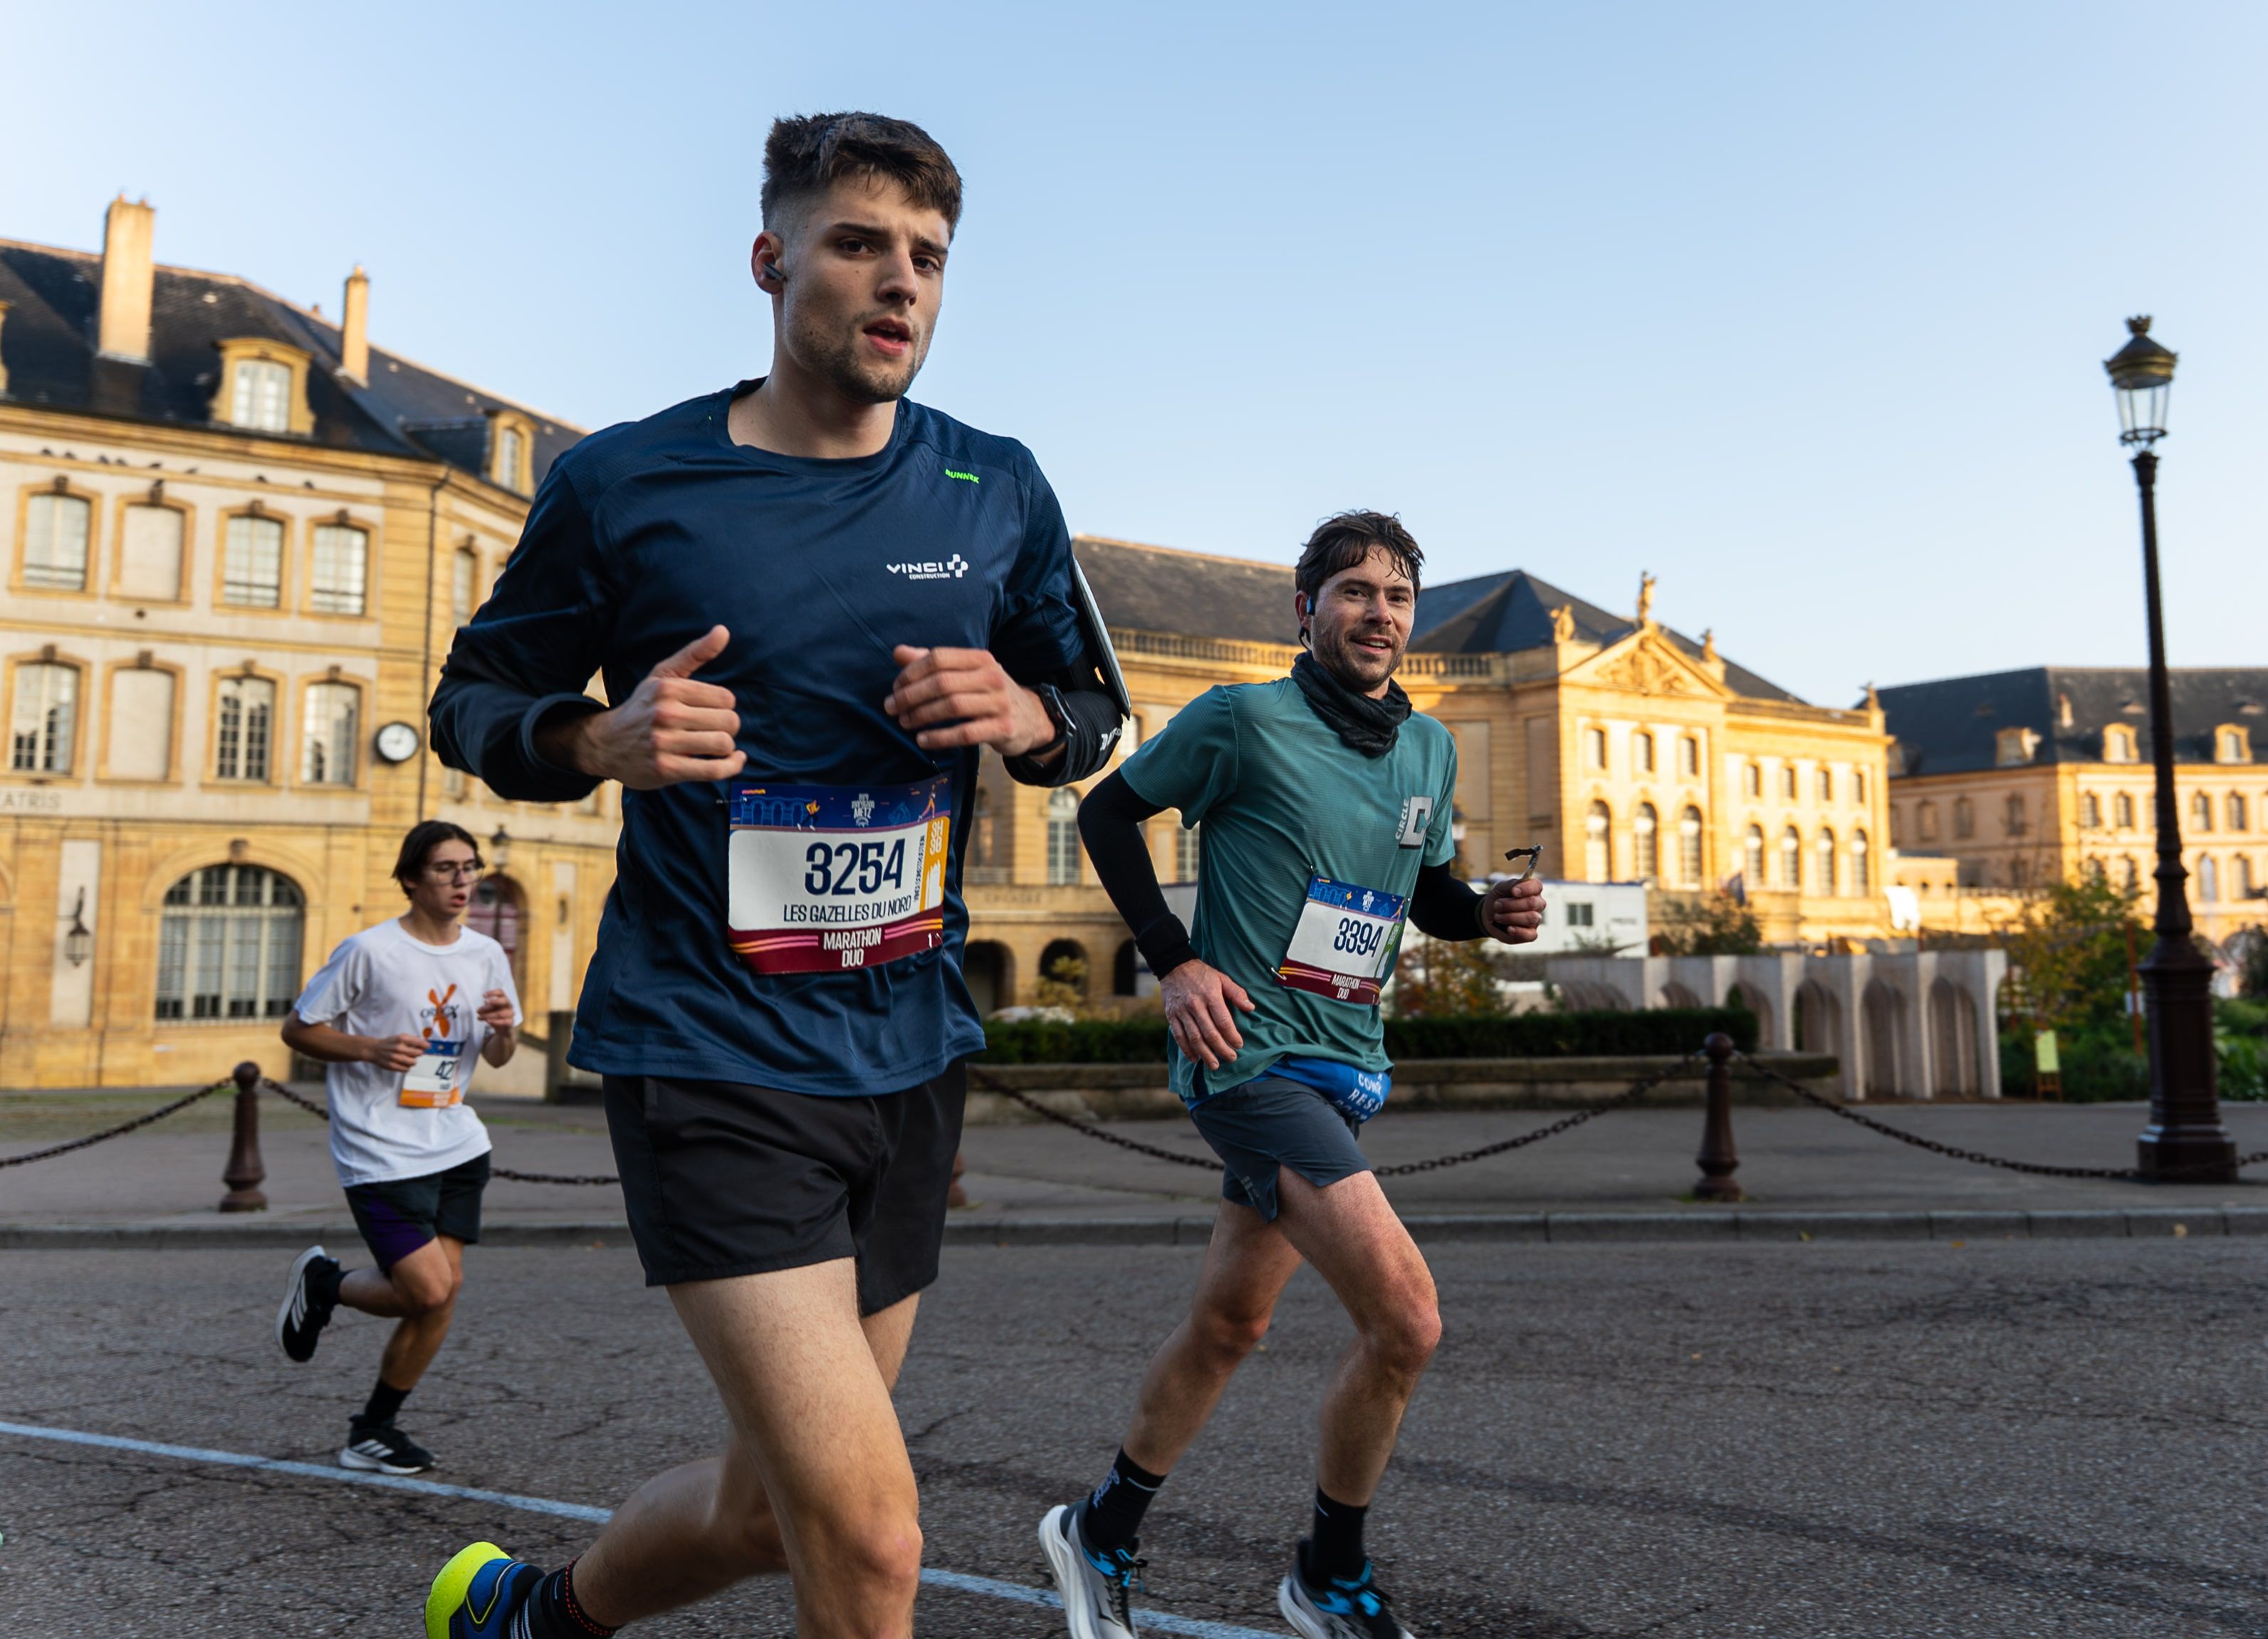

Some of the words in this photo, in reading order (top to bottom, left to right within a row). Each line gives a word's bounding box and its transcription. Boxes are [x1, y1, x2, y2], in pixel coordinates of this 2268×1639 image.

[886, 561, 944, 574] VINCI
[909, 572, 951, 581] CONSTRUCTION
[1395, 798, 1410, 841] CIRCLE
[804, 838, 906, 896] 3254
[783, 904, 808, 923] LES
[810, 904, 870, 923] GAZELLES
[871, 900, 887, 920] DU
[887, 895, 912, 916] NORD
[823, 927, 882, 951] MARATHON
[1334, 917, 1384, 958] 3394
[841, 948, 864, 968] DUO
[1332, 974, 1361, 990] MARATHON
[1337, 987, 1350, 1000] DUO
[435, 1059, 458, 1081] 42
